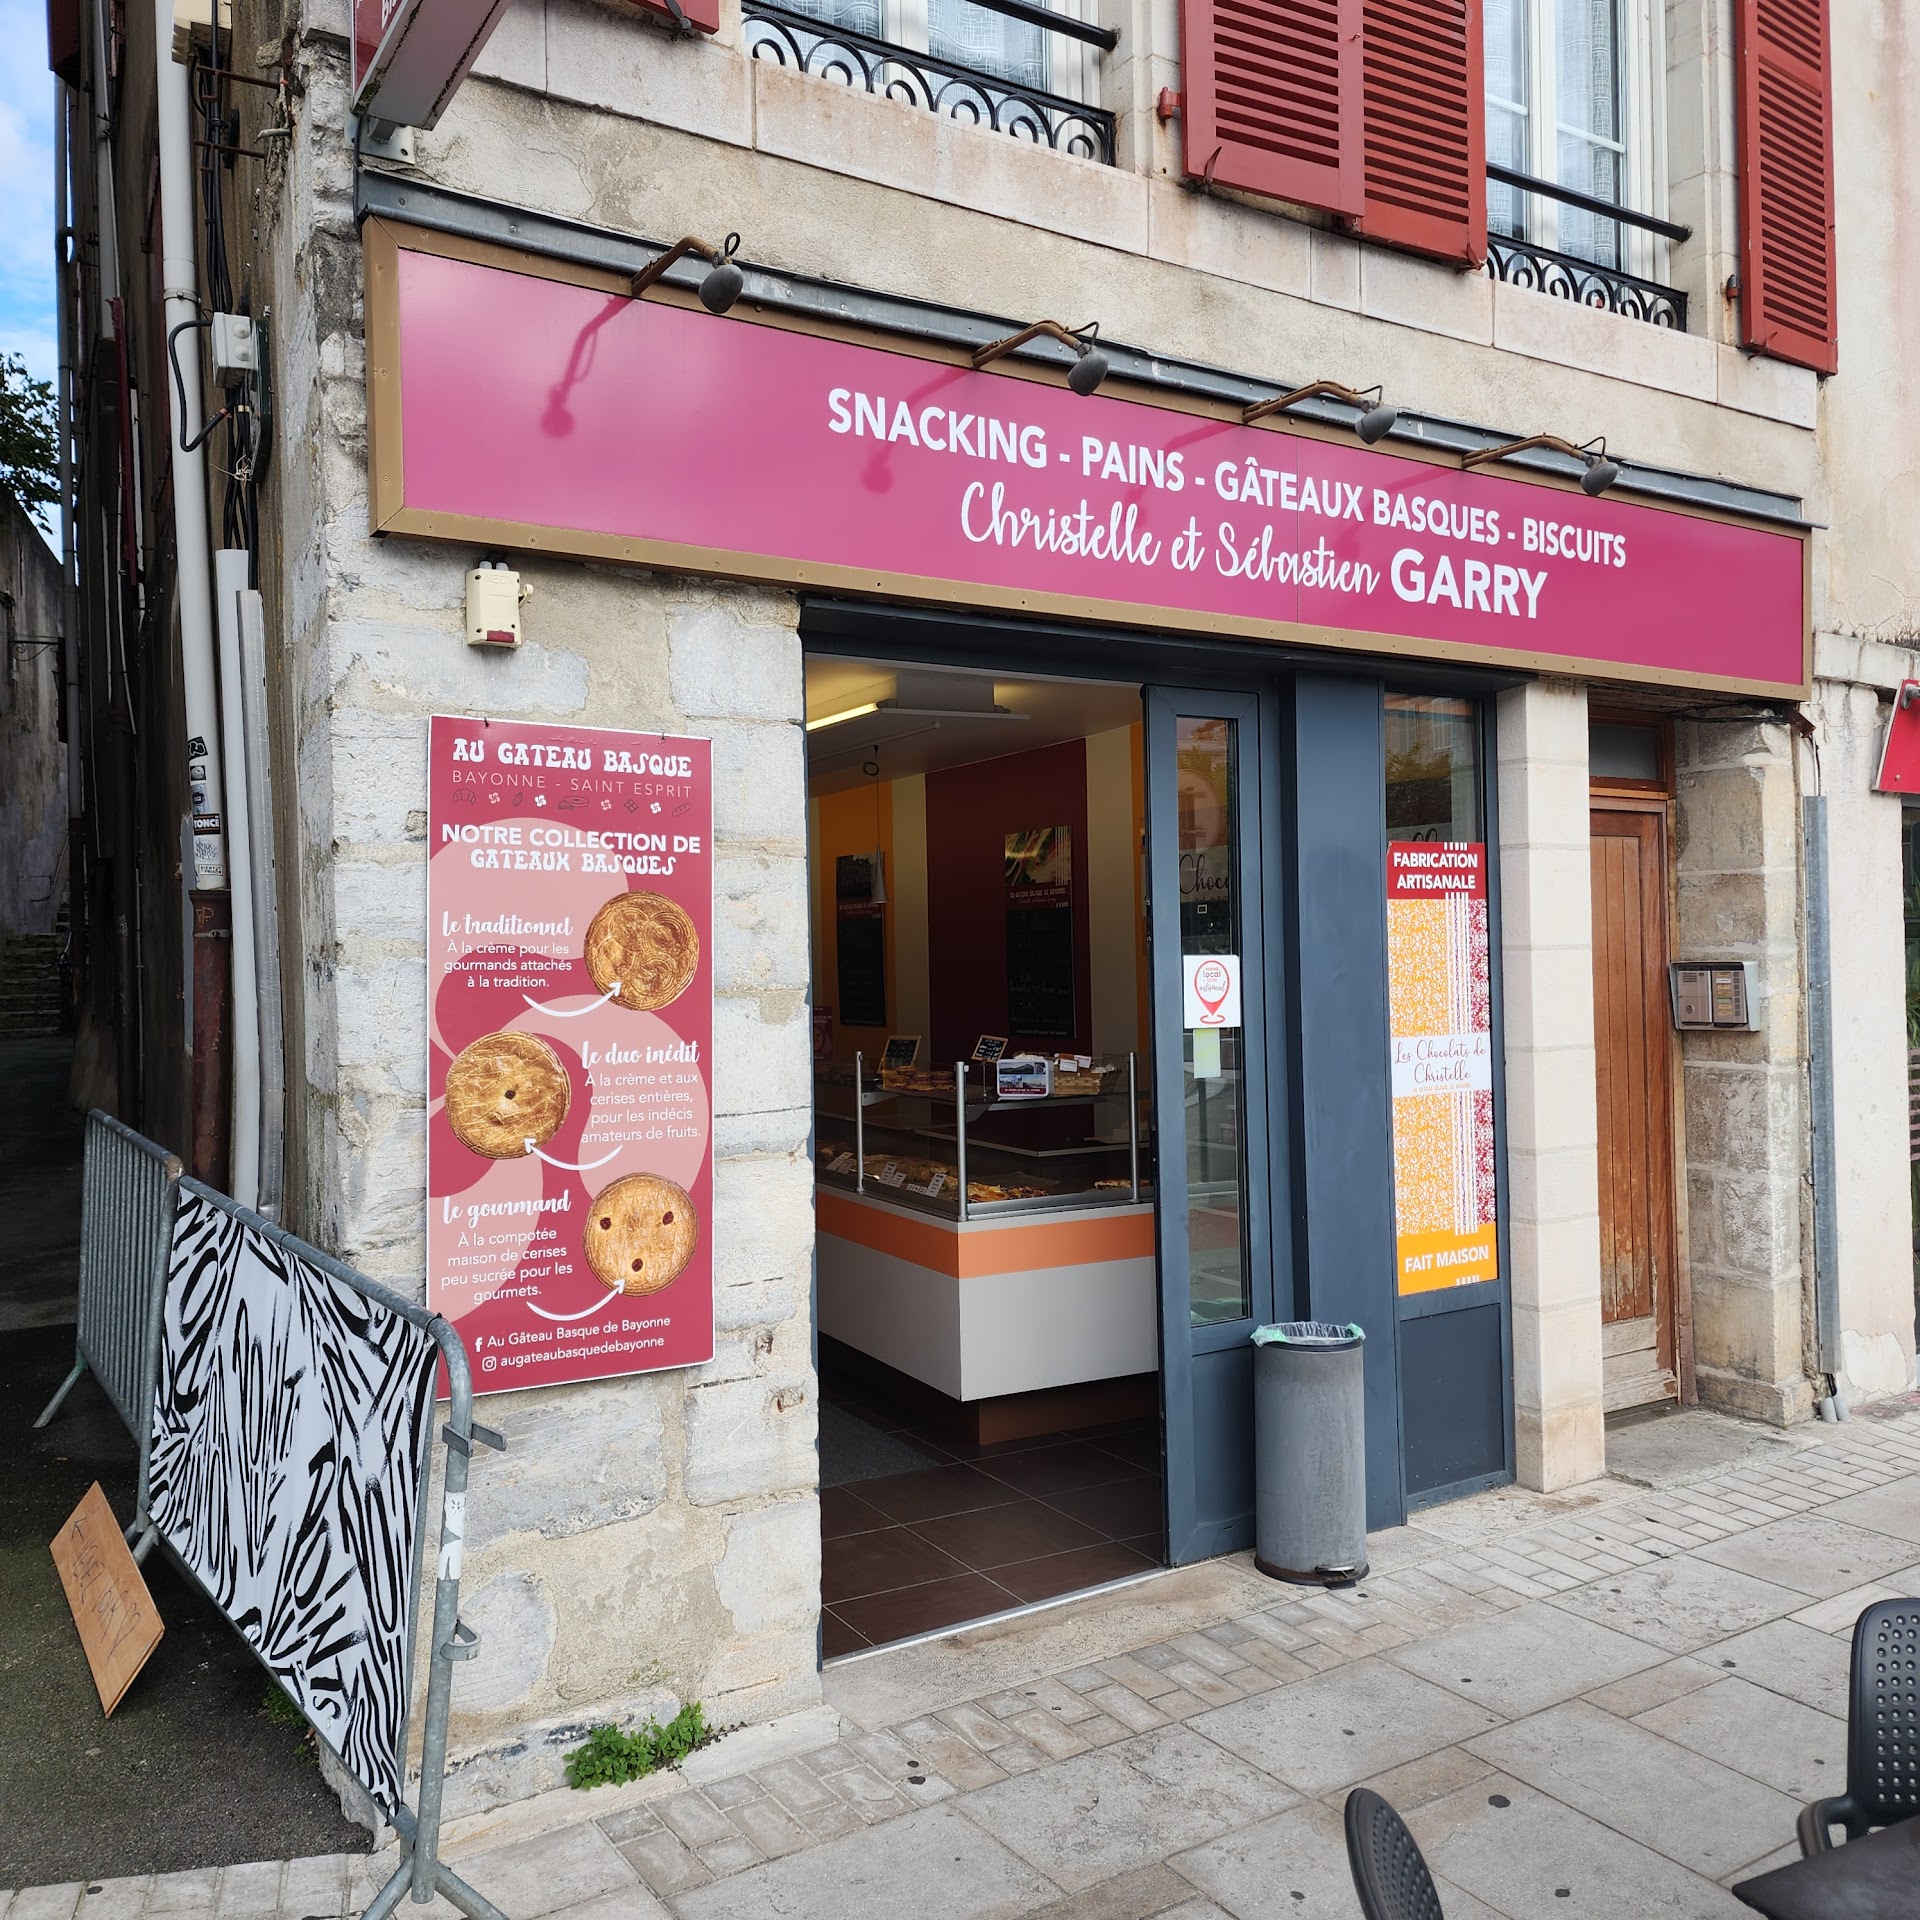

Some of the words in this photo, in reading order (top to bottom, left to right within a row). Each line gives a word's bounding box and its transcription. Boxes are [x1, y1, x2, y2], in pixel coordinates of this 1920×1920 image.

[828, 388, 1047, 468] SNACKING
[1082, 436, 1184, 491] PAINS
[1215, 456, 1364, 521] GÂTEAUX
[1374, 489, 1500, 545] BASQUES
[1523, 517, 1626, 568] BISCUITS
[961, 482, 1161, 566] Christelle
[1171, 516, 1205, 571] et
[1215, 522, 1380, 596] Sébastien
[1391, 548, 1548, 620] GARRY
[453, 738, 485, 762] AU
[497, 742, 592, 771] GATEAU
[604, 750, 692, 778] BASQUE
[452, 771, 546, 789] BAYONNE
[570, 778, 624, 794] SAINT
[634, 783, 692, 799] ESPRIT
[442, 824, 522, 846] NOTRE
[529, 828, 666, 852] COLLECTION
[674, 836, 701, 854] DE
[470, 848, 571, 873] GATEAUX
[581, 853, 677, 876] BASQUES
[1393, 852, 1478, 868] FABRICATION
[1396, 873, 1476, 890] ARTISANALE
[464, 913, 574, 937] traditionnel
[447, 939, 458, 954] À
[461, 940, 473, 954] la
[476, 942, 516, 955] crème
[519, 944, 549, 958] pour
[552, 942, 569, 955] les
[444, 957, 518, 974] gourmands
[520, 957, 573, 972] attachés
[1202, 970, 1221, 978] local
[467, 975, 475, 988] à
[479, 975, 490, 988] la
[493, 975, 550, 988] tradition.
[605, 1042, 642, 1066] duo
[646, 1040, 700, 1065] inédit
[1394, 1041, 1413, 1064] Les
[1416, 1038, 1470, 1061] Chocolats
[1473, 1036, 1486, 1056] de
[585, 1072, 596, 1087] À
[600, 1073, 611, 1087] la
[615, 1072, 656, 1086] crème
[659, 1072, 673, 1085] et
[676, 1073, 698, 1085] aux
[1413, 1059, 1471, 1084] Christelle
[590, 1092, 635, 1106] cerises
[639, 1090, 693, 1105] entières,
[591, 1111, 623, 1128] pour
[626, 1109, 644, 1123] les
[648, 1108, 693, 1121] indécis
[581, 1130, 642, 1144] amateurs
[646, 1126, 663, 1140] de
[666, 1125, 701, 1139] fruits.
[467, 1189, 572, 1229] gourmand
[458, 1232, 469, 1248] À
[473, 1232, 485, 1246] la
[488, 1227, 557, 1247] compotée
[448, 1252, 497, 1267] maison
[501, 1249, 518, 1263] de
[522, 1246, 567, 1260] cerises
[1404, 1253, 1434, 1274] FAIT
[1436, 1244, 1490, 1268] MAISON
[441, 1273, 468, 1290] peu
[471, 1268, 516, 1284] sucrée
[520, 1266, 551, 1284] pour
[555, 1262, 573, 1276] les
[473, 1286, 542, 1306] gourmets.
[487, 1335, 505, 1349] Au
[508, 1328, 553, 1346] Gâteau
[556, 1324, 600, 1342] Basque
[602, 1320, 619, 1334] de
[622, 1314, 671, 1334] Bayonne
[500, 1336, 665, 1369] augateaubasquedebayonne
